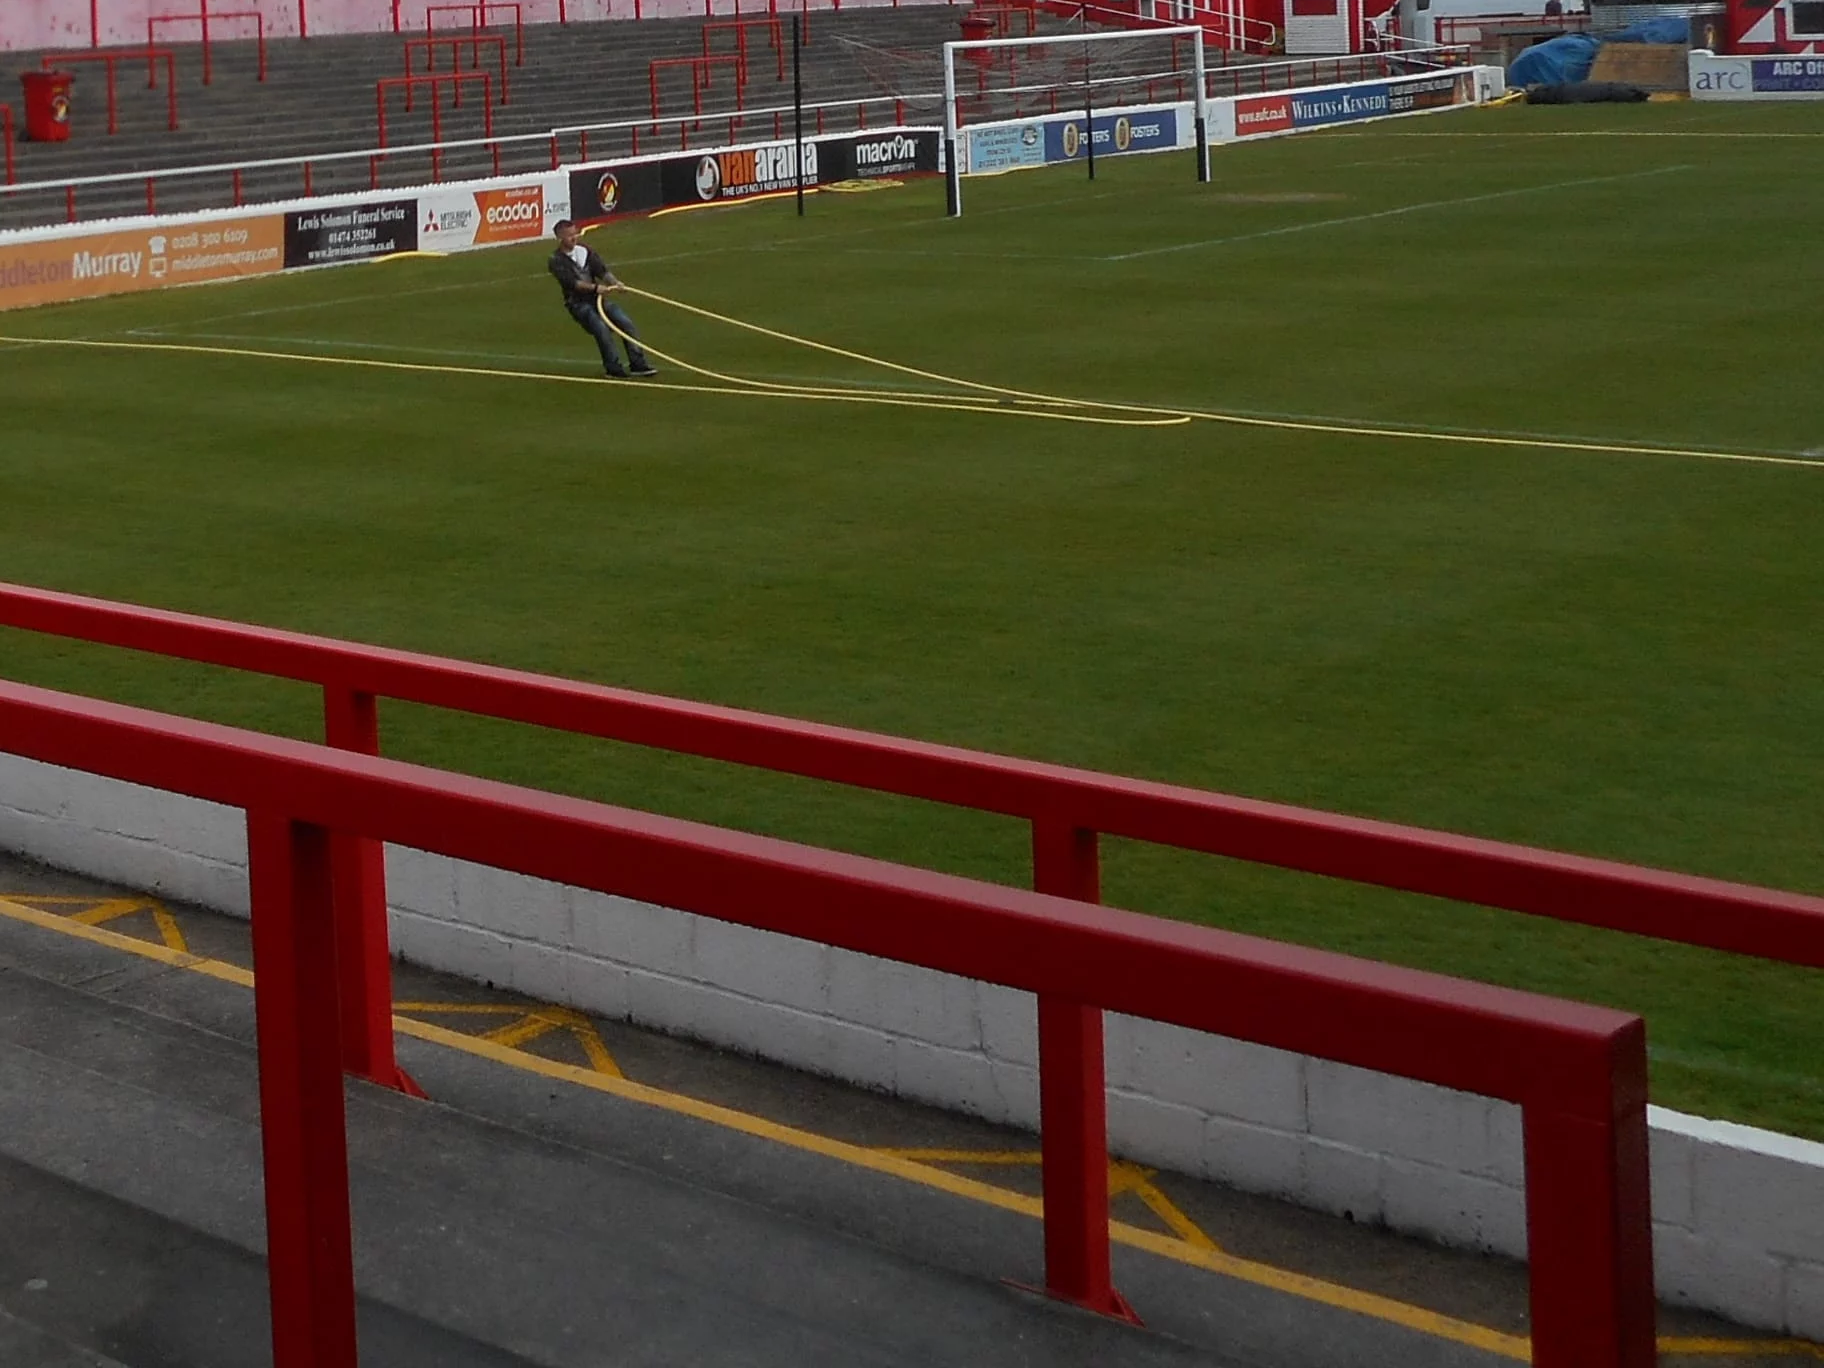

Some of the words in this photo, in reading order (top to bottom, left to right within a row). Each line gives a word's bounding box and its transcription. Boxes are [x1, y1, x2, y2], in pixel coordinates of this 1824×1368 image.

[1773, 62, 1803, 75] ARC
[1696, 71, 1744, 90] arc
[857, 135, 915, 164] macron
[722, 186, 735, 196] THE
[298, 215, 320, 231] Lewis
[320, 213, 351, 229] Solomon
[353, 208, 379, 225] Funeral
[380, 206, 405, 221] Service
[487, 201, 539, 223] ecodan
[441, 219, 467, 230] ELECTRIC
[73, 250, 143, 279] Murray
